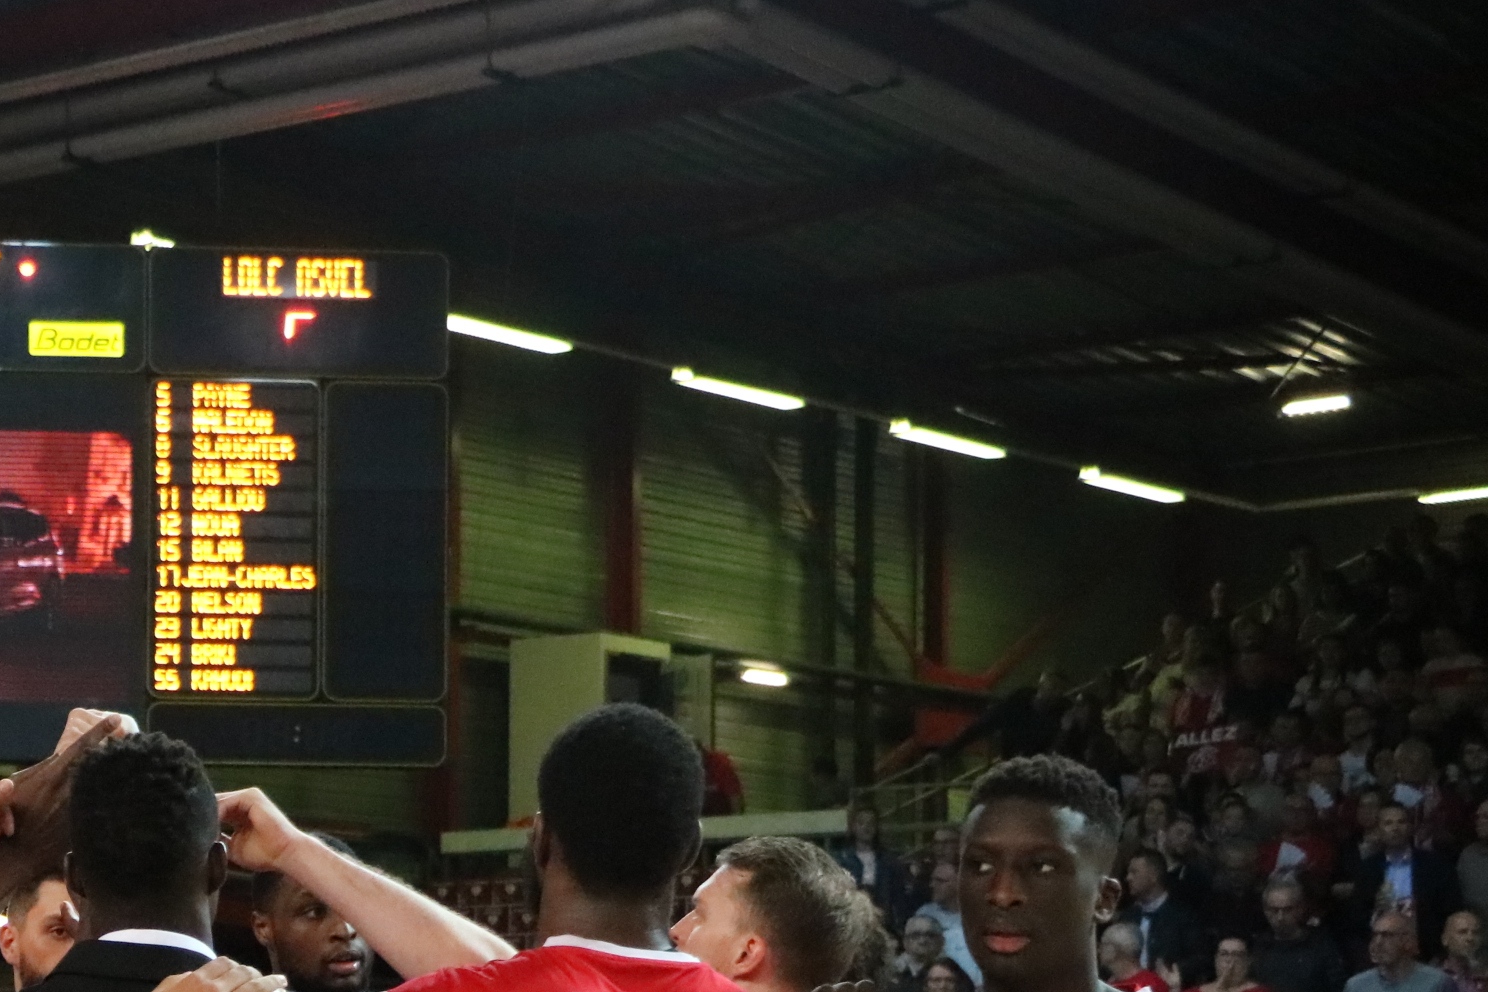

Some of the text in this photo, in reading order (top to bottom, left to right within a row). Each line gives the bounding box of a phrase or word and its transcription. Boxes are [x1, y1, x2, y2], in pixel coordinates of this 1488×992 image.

[35, 328, 123, 351] Bodet
[155, 382, 172, 407] 5
[155, 408, 172, 433] 6
[155, 434, 296, 460] 8 SLAUGHTER
[155, 460, 172, 485] 9
[158, 486, 180, 510] 11
[156, 511, 183, 536] 12
[156, 537, 244, 563] 15 BILAN
[156, 563, 316, 589] 17 JEAN-CHARLES
[154, 589, 262, 615] 20 NELSON
[154, 615, 253, 641] 23 LIGHTY
[154, 641, 182, 666] 24
[153, 667, 181, 691] 55
